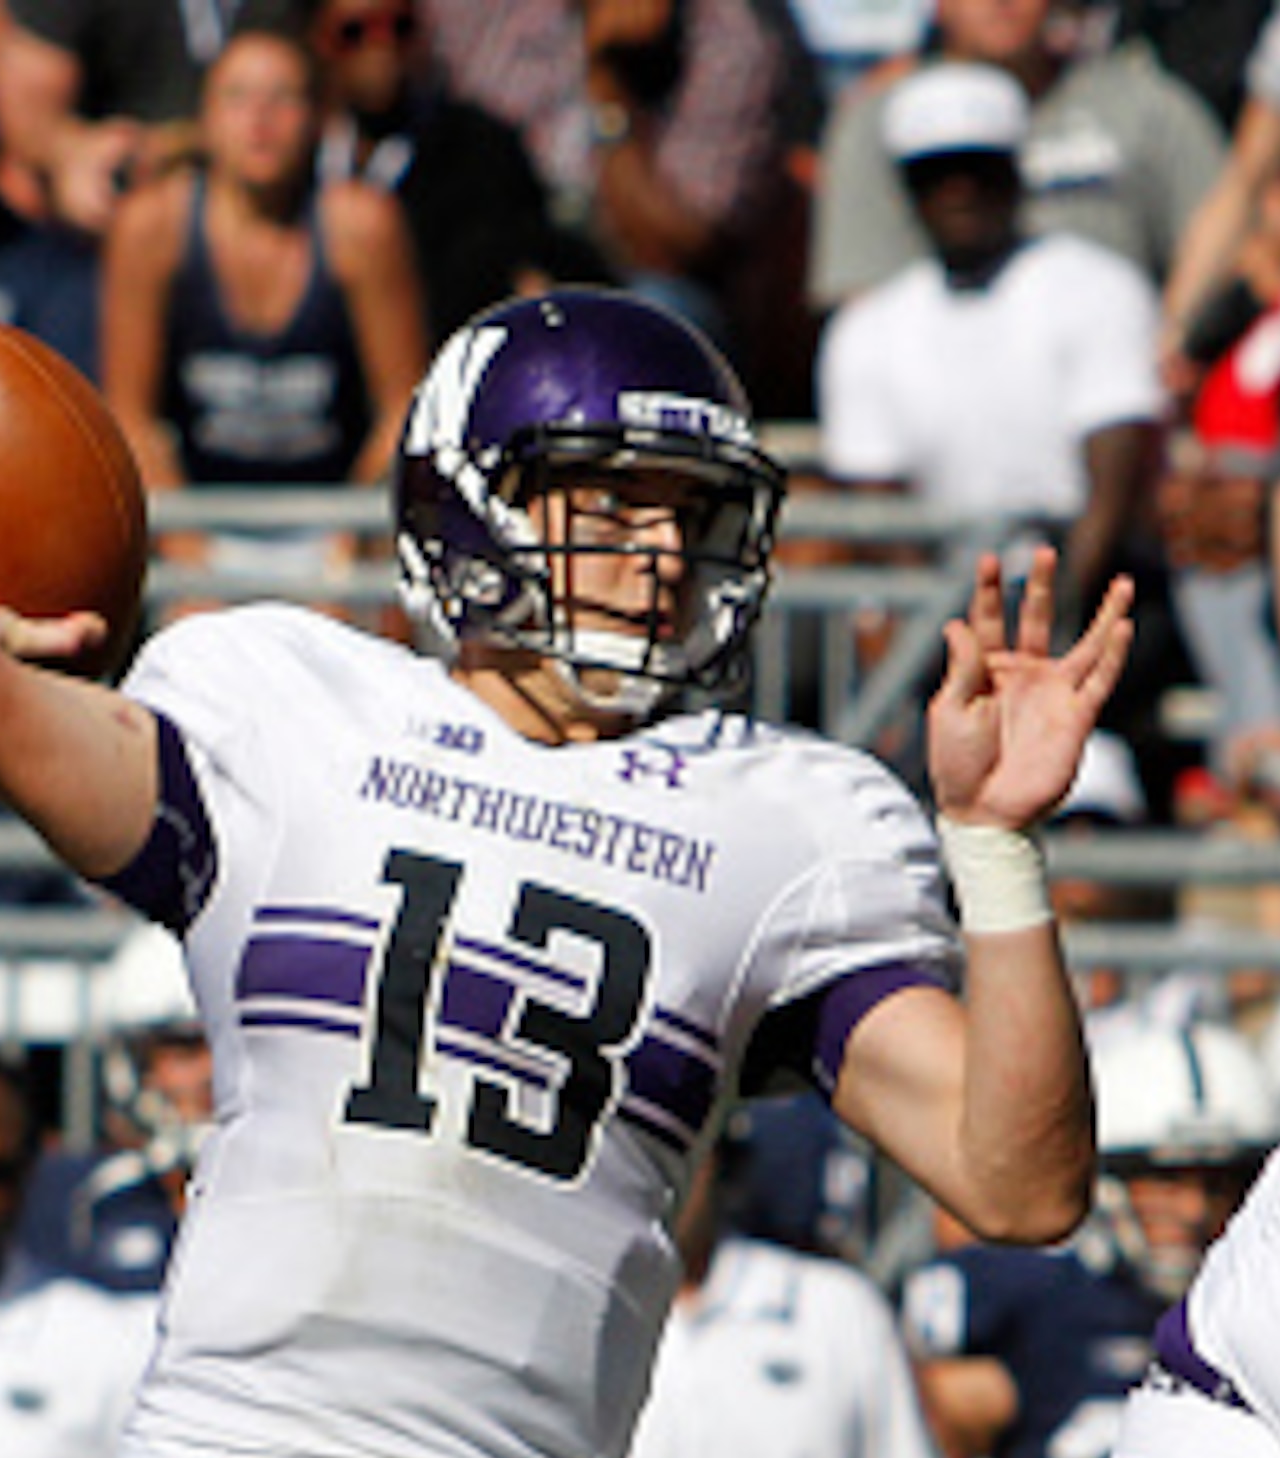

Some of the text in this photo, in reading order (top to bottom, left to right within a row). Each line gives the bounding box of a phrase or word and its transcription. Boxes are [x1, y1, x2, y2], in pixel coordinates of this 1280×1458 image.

[404, 324, 509, 457] N
[358, 756, 716, 893] NORTHWESTERN
[337, 848, 654, 1186] 13
